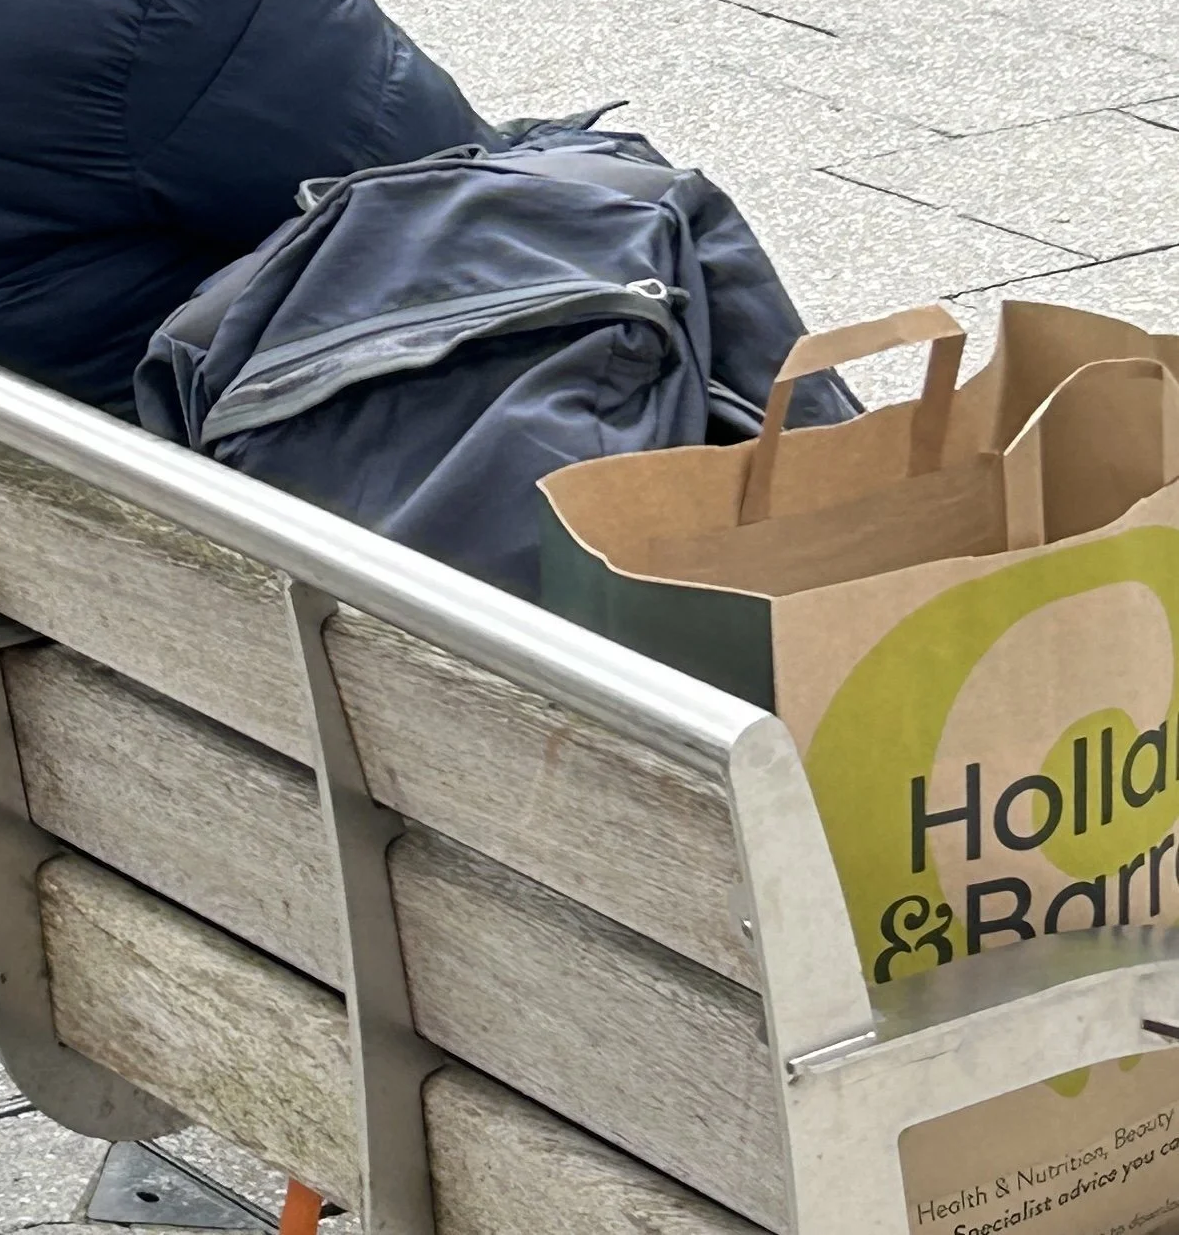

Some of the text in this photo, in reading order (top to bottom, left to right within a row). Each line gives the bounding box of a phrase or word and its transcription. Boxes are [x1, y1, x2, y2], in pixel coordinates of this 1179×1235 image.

[910, 712, 1179, 873] Holla
[917, 1108, 1174, 1225] Health & Nutrition, Beauty
[1058, 1168, 1118, 1206] advice
[1122, 1149, 1155, 1183] you
